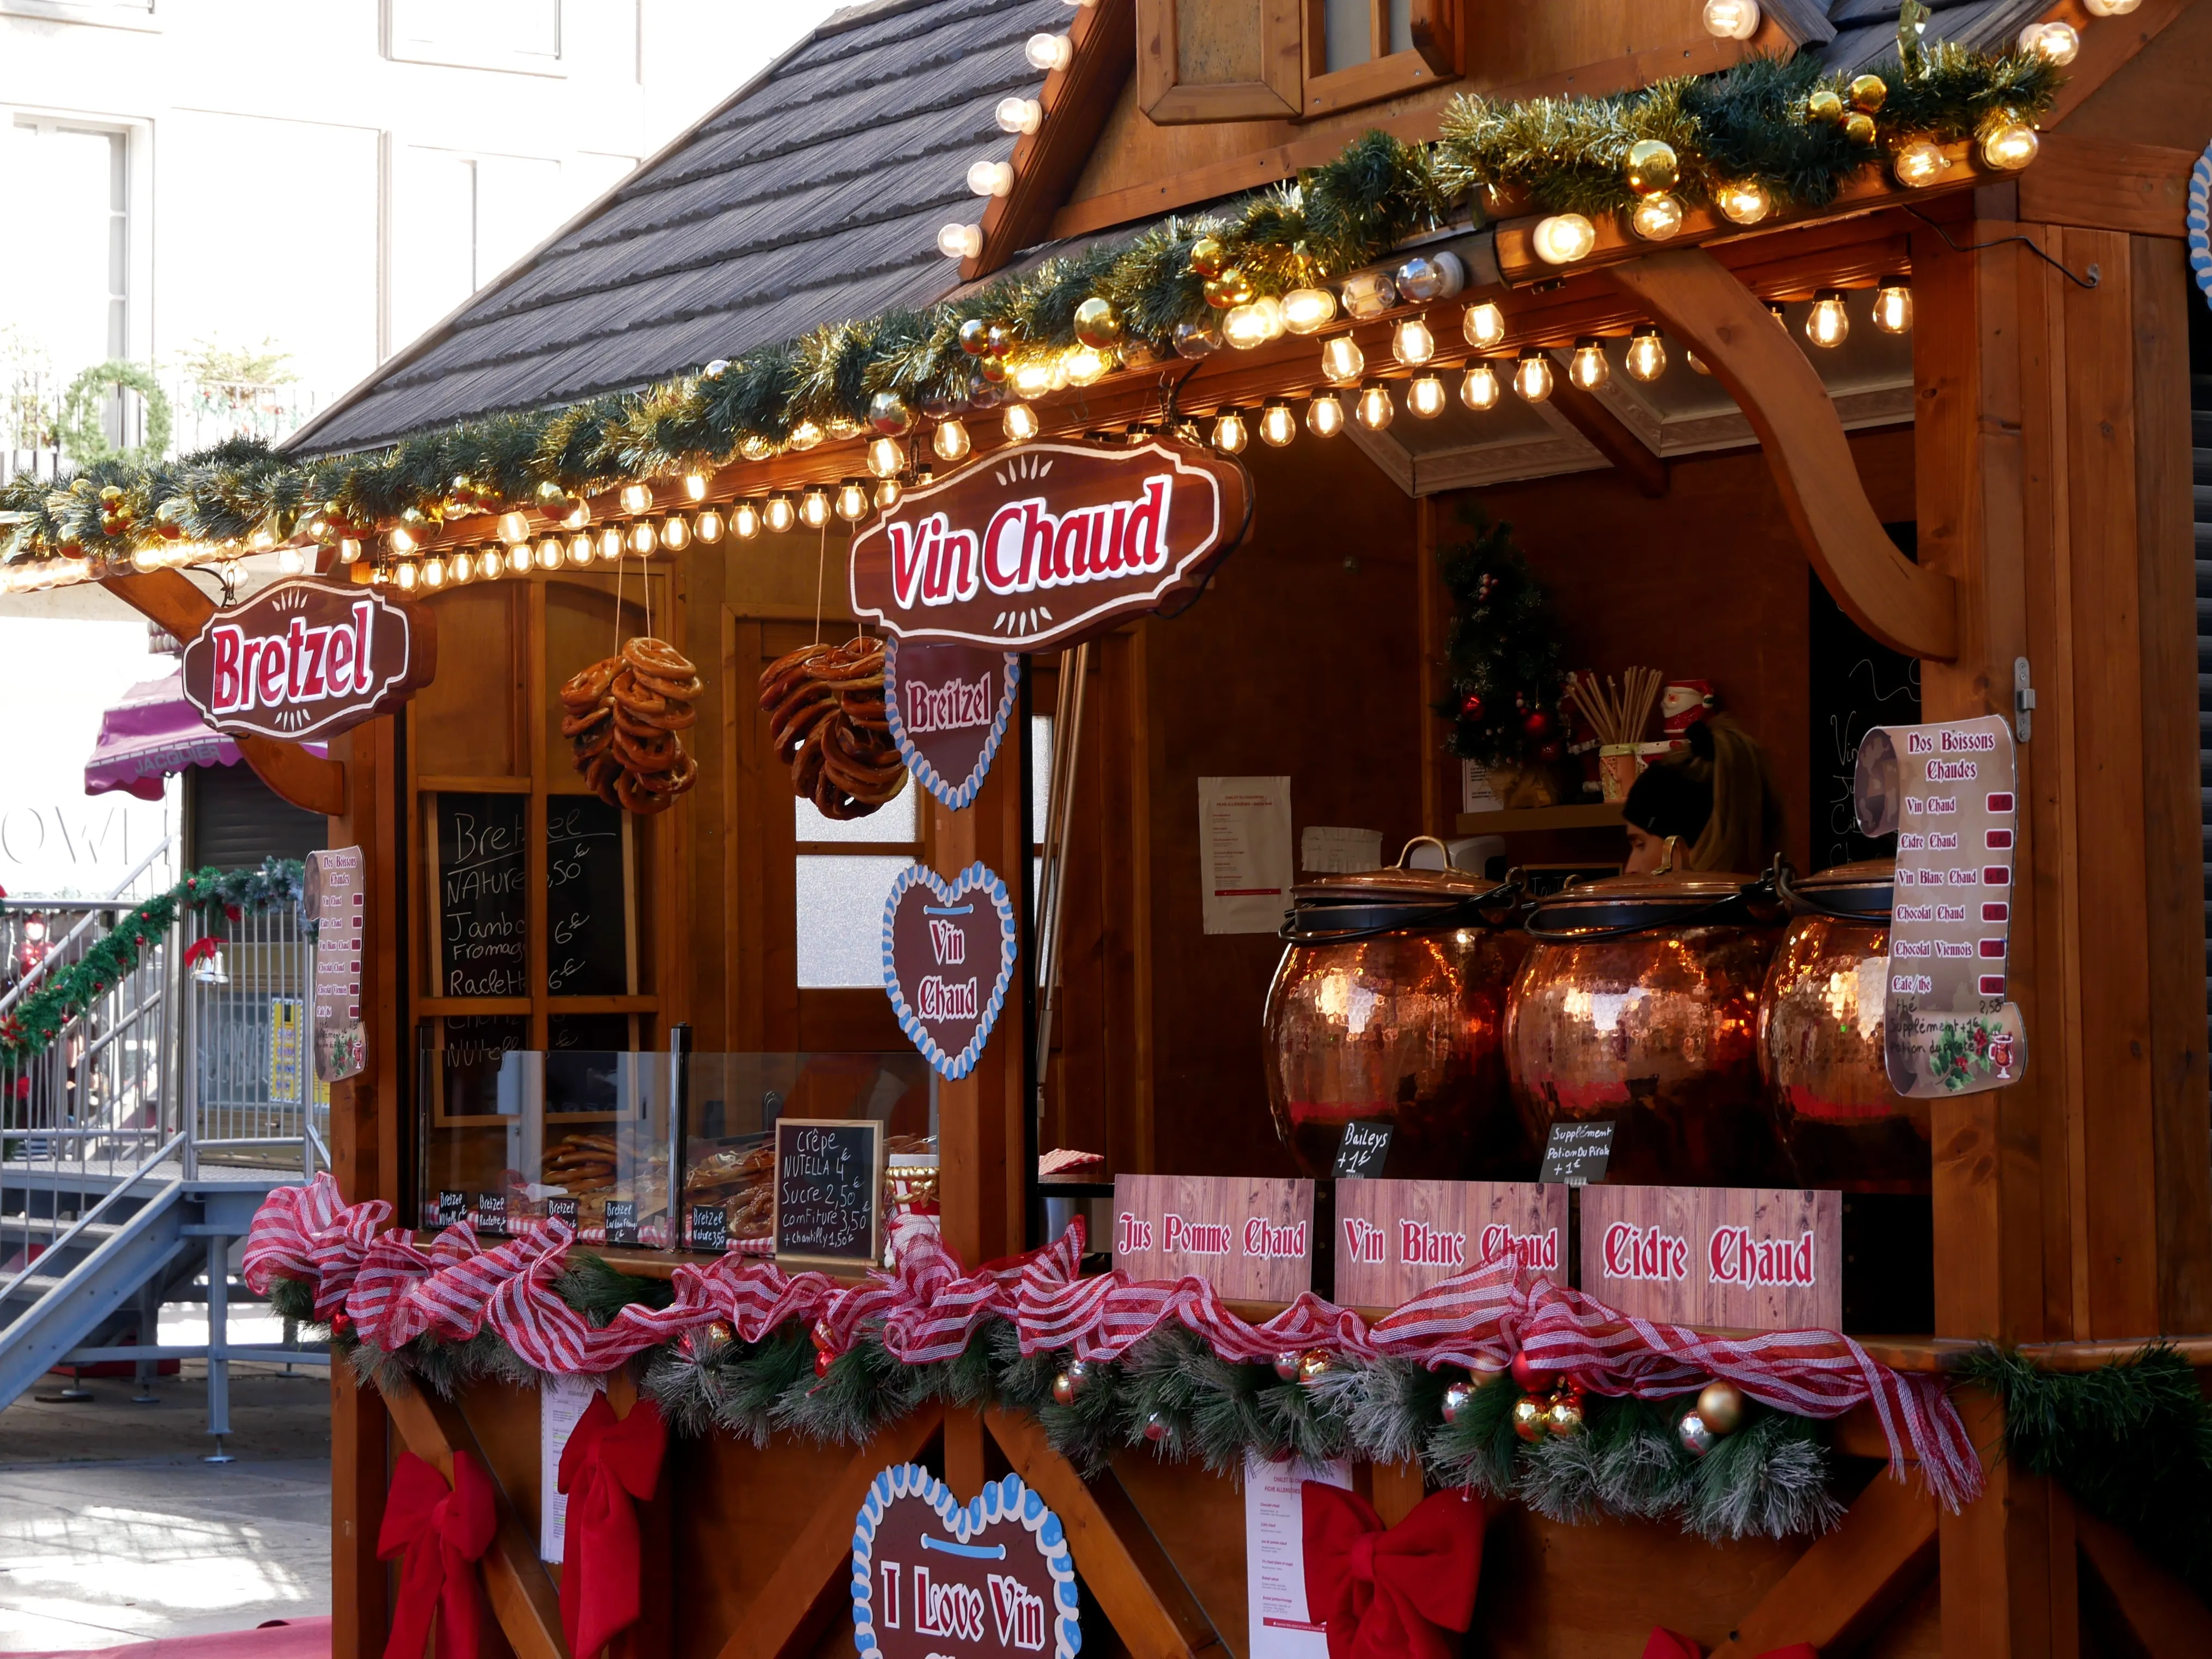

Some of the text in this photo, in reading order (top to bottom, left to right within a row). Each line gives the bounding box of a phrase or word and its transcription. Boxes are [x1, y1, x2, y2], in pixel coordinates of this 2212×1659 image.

[889, 474, 1173, 610] Vin Chaud
[212, 600, 374, 714] Bretzel
[905, 672, 992, 733] Breitzel
[1908, 730, 1995, 754] Nos Boissons
[135, 745, 221, 775] JACQUIER
[1926, 758, 1978, 782] Chaudes
[1906, 796, 1923, 815] Vin
[1927, 796, 1956, 816] Chaud
[454, 809, 582, 865] Bretel
[1900, 834, 1924, 849] Cidre
[1929, 832, 1958, 852] Chaud
[335, 855, 357, 868] Boissons
[1898, 869, 1914, 886] Vin
[1919, 869, 1944, 886] Blanc
[1949, 868, 1977, 887] Chaud
[1895, 903, 1931, 921] Chocolat
[1936, 903, 1965, 921] Chaud
[453, 943, 525, 963] Fromag
[929, 919, 965, 965] Vin
[1894, 939, 1930, 958] Chocolat
[1934, 940, 1973, 958] Viennois
[451, 969, 525, 995] Raclett
[1892, 975, 1931, 994] Café/thé
[918, 975, 978, 1024] Chaud
[1553, 1125, 1612, 1143] Supplément
[783, 1154, 830, 1179] NUTELLA
[440, 1192, 463, 1208] Bretzel
[479, 1194, 505, 1211] Bretzel
[782, 1182, 823, 1205] Sucre
[549, 1200, 575, 1216] Bretzel
[607, 1203, 633, 1216] Bretzel
[694, 1207, 723, 1226] Bretzel
[479, 1214, 501, 1226] Raclette
[1119, 1212, 1307, 1260] Jus Pomme Chaud
[1343, 1218, 1559, 1271] Vin Blanc Chaud
[1602, 1221, 1815, 1291] Cidre Chaud
[881, 1560, 1045, 1651] I Love Vin
